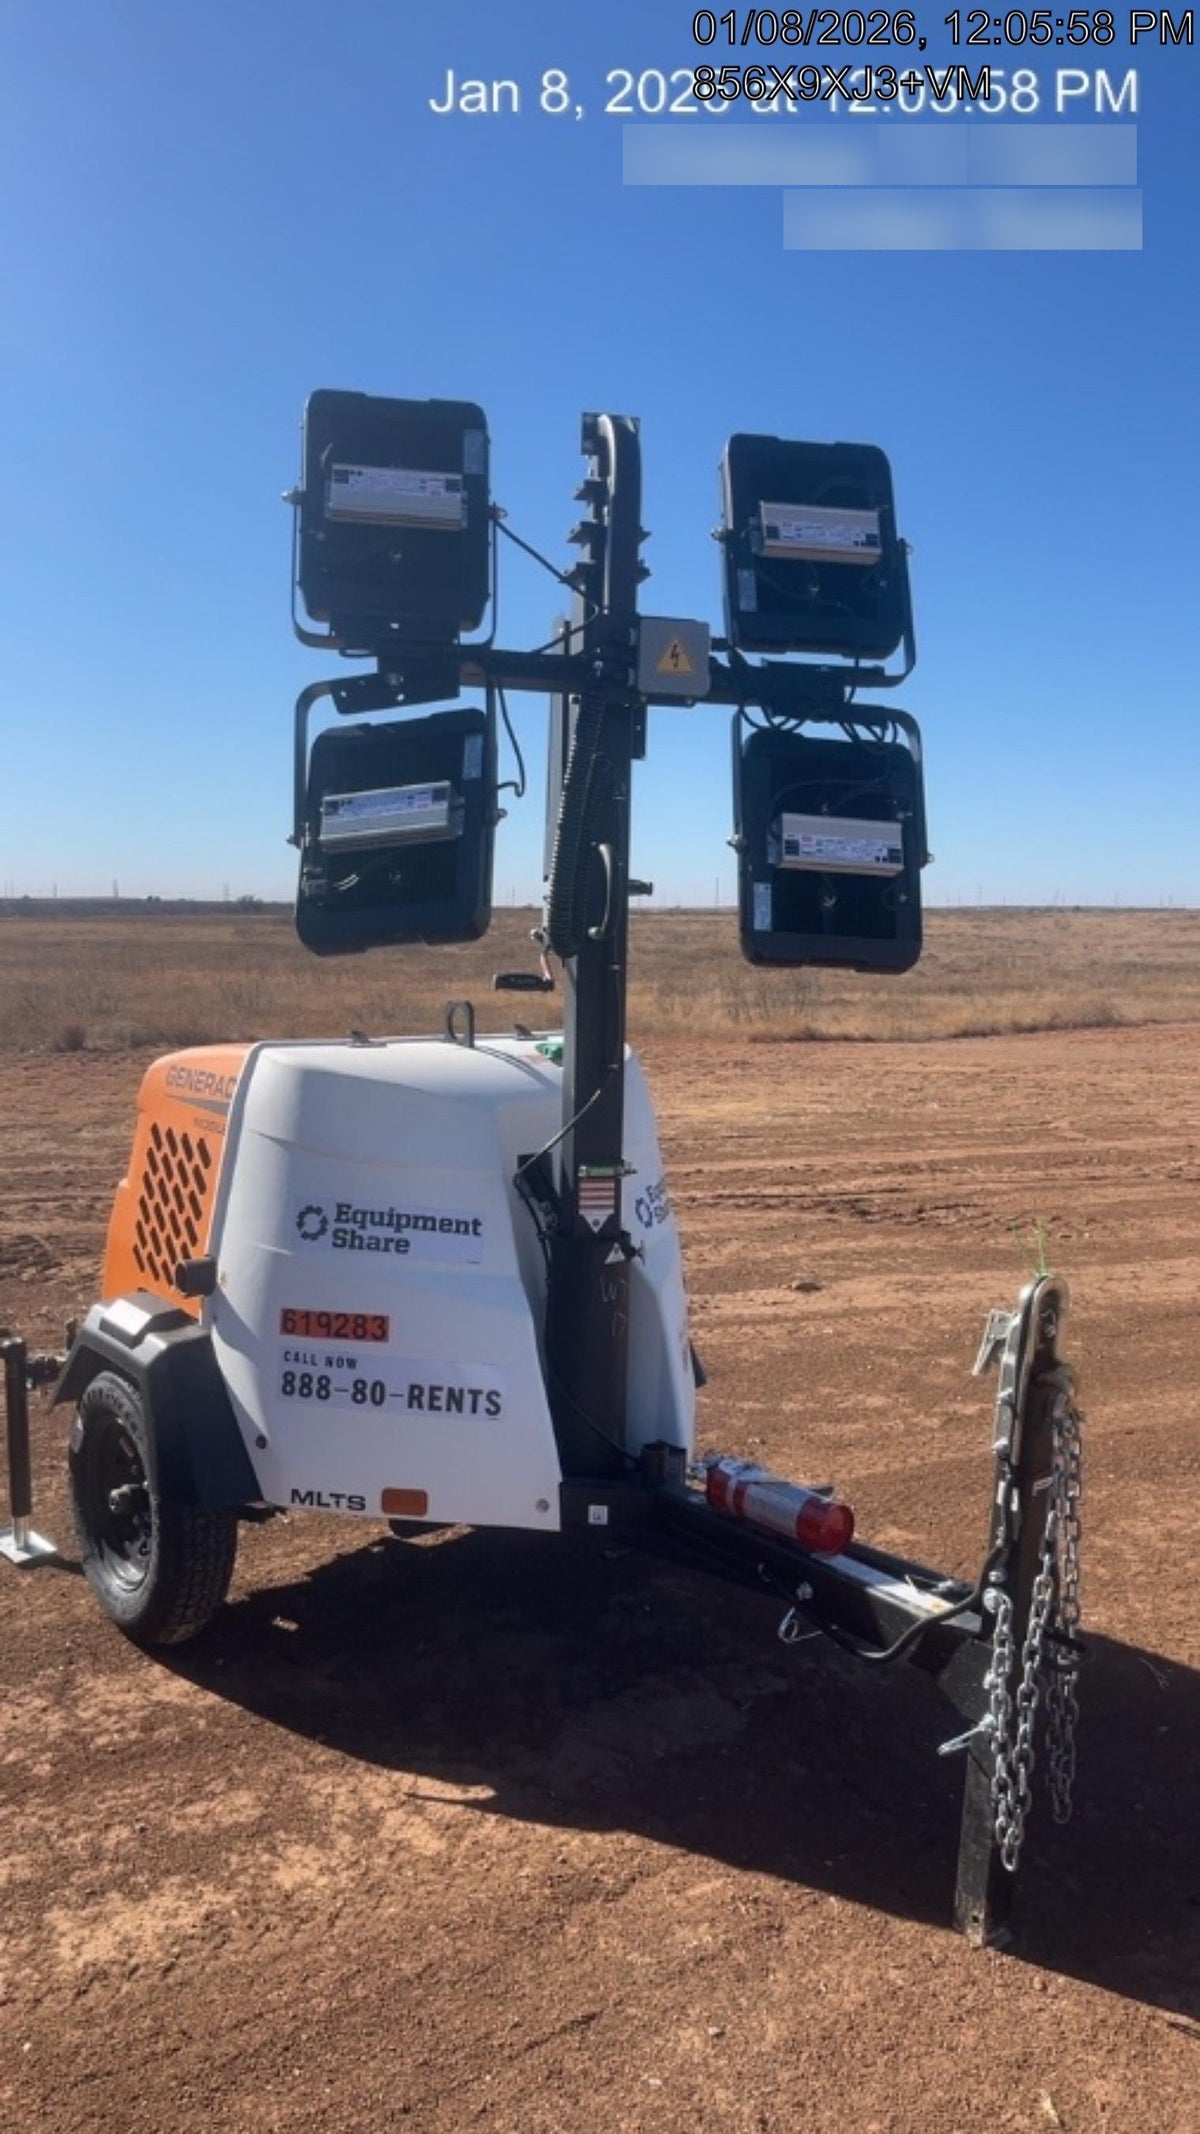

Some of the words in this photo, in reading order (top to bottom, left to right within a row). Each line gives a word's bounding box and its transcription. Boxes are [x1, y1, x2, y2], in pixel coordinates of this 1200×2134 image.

[334, 1202, 482, 1237] Equipment
[331, 1227, 411, 1254] Share
[282, 1308, 387, 1341] 619283
[284, 1351, 318, 1367] CALL
[324, 1355, 358, 1370] NOW
[281, 1370, 502, 1417] 888-80-RENTS
[291, 1488, 367, 1512] MLTS
